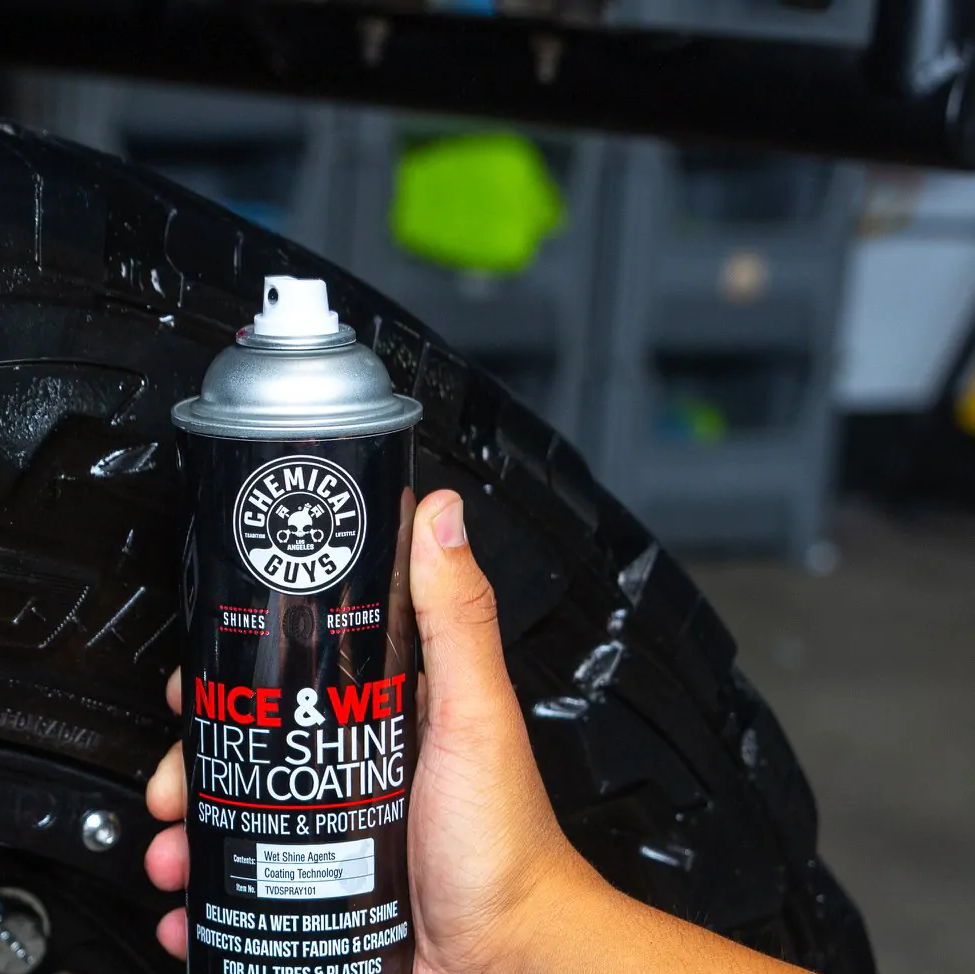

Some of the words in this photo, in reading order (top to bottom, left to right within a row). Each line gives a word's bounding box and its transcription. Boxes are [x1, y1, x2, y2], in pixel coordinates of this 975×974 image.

[243, 466, 356, 528] CHEMICAL
[286, 543, 315, 551] ANGELES
[335, 530, 356, 538] LIFESTYLE
[263, 552, 337, 583] GUYS
[223, 612, 266, 630] SHINES
[327, 608, 380, 629] RESTORES
[195, 676, 281, 727] NICE
[293, 687, 326, 727] &
[327, 673, 406, 725] WET
[195, 717, 270, 764] TIRE
[284, 715, 405, 766] SHINE
[196, 753, 260, 799] TRIM
[266, 752, 404, 801] COATING
[198, 801, 236, 830] SPRAY
[241, 812, 290, 835] SHINE
[296, 814, 310, 836] &
[316, 798, 405, 834] PROTECTANT
[233, 854, 256, 865] Contents:
[264, 851, 280, 862] Wet
[282, 852, 305, 862] Shine
[308, 851, 336, 863] Agents
[235, 883, 247, 892] Item
[265, 886, 316, 895] TVDSPRAY101
[264, 868, 294, 880] Coating
[297, 868, 343, 879] Technology
[205, 902, 255, 930] DELIVERS
[258, 913, 267, 931] A
[269, 914, 299, 932] WET
[304, 909, 367, 932] BRILLIANT
[369, 900, 398, 924] SHINE
[196, 923, 242, 953] PROTECTS
[244, 938, 298, 958] AGAINST
[302, 937, 349, 958] FADING
[352, 936, 361, 953] &
[363, 921, 408, 951] CRACKING
